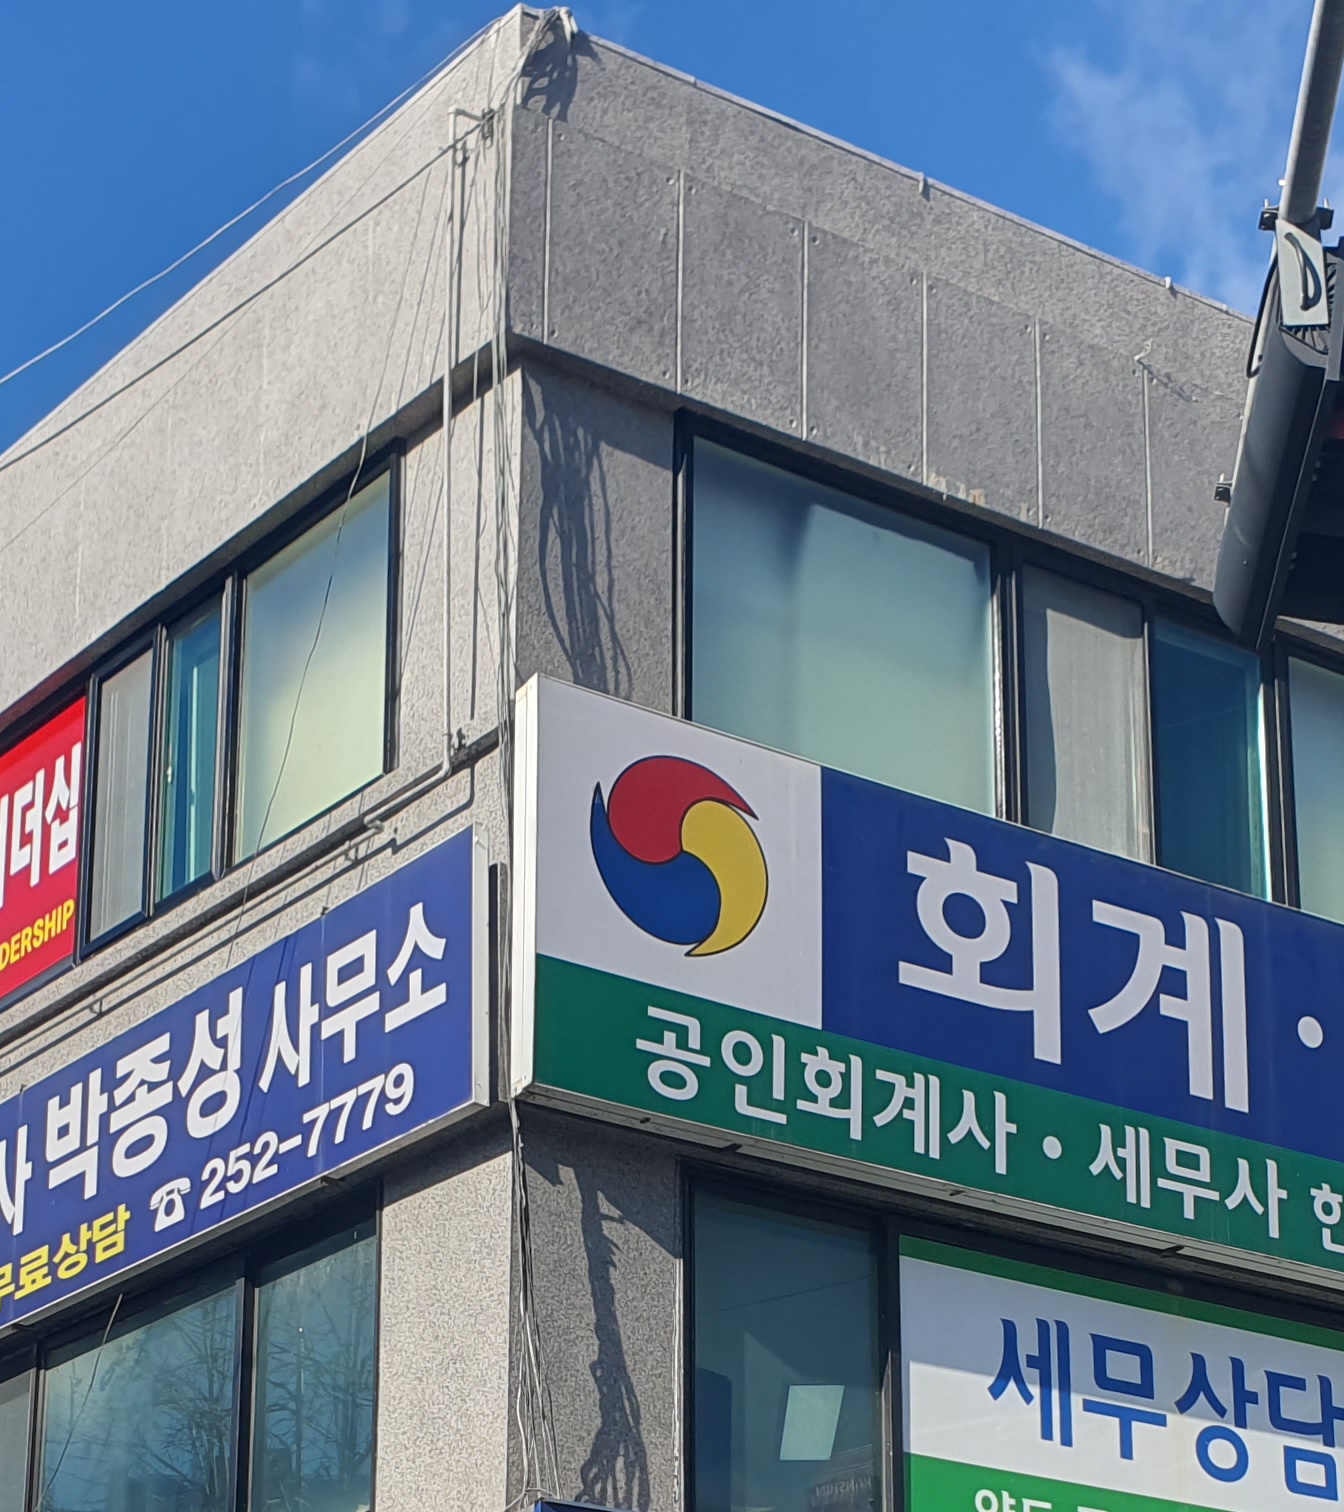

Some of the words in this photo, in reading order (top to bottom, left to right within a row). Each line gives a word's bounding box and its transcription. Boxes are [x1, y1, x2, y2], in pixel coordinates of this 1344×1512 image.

[45, 986, 244, 1201] 박종성
[258, 901, 447, 1093] 사무소
[199, 1063, 415, 1211] 252-7779
